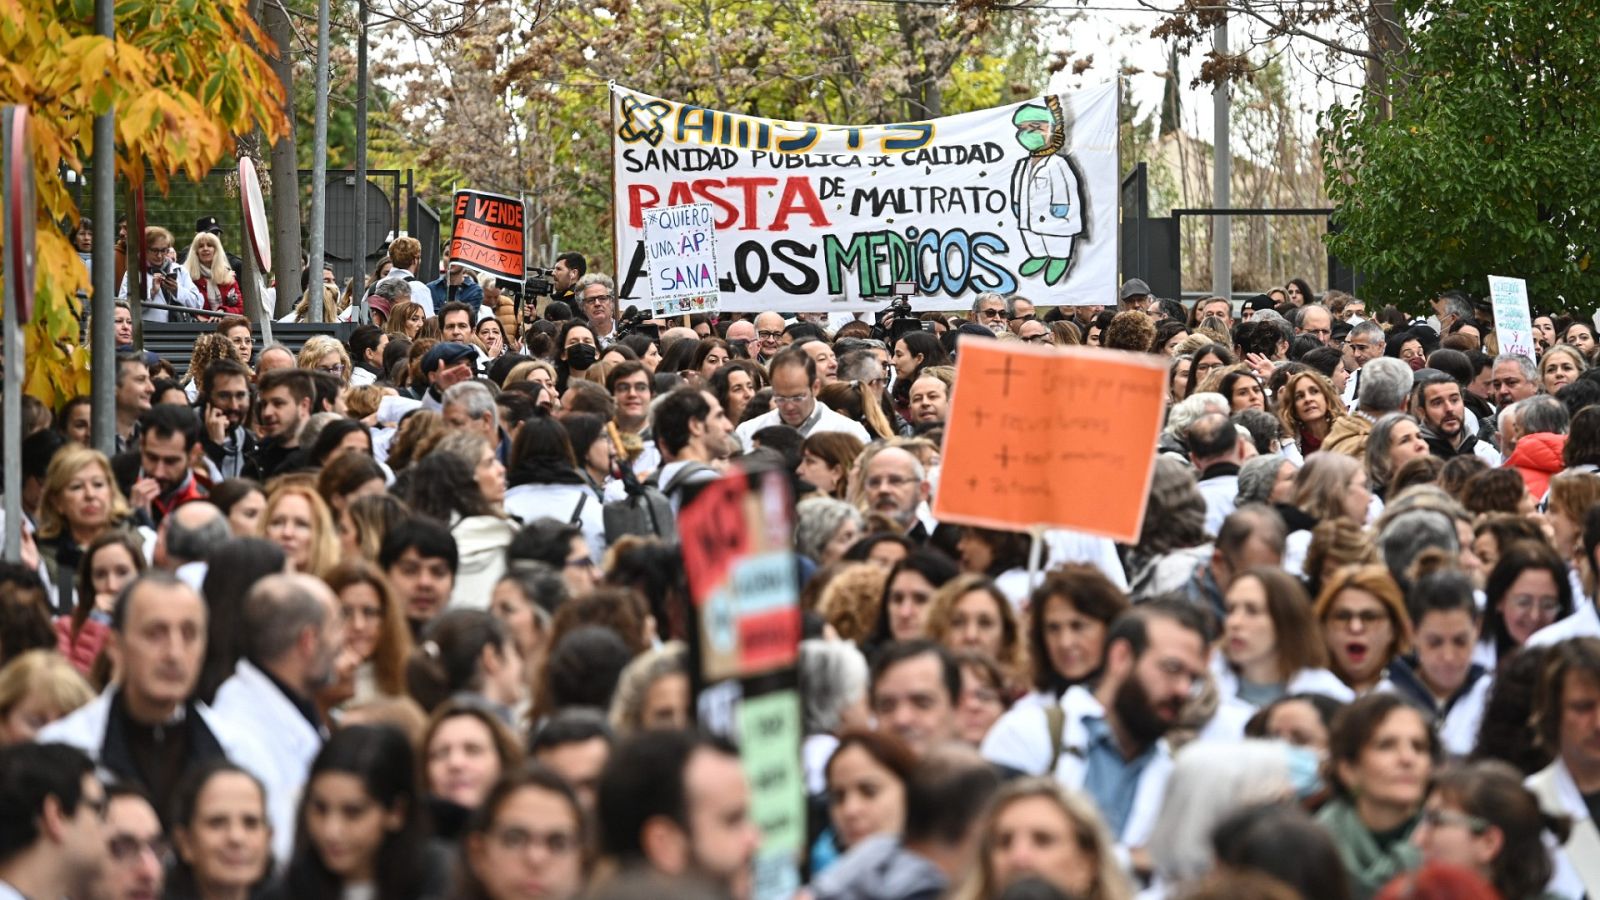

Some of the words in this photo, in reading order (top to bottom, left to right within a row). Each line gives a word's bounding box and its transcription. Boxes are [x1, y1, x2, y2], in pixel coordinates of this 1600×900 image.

[623, 147, 738, 173] SANIDAD
[750, 149, 862, 169] PUBLICA
[901, 142, 1005, 166] CALIDAD
[820, 176, 847, 200] DE
[850, 186, 1007, 217] MALTRATO
[474, 198, 523, 228] VENDE
[458, 221, 518, 246] ATENCION
[650, 240, 676, 259] UNA
[681, 232, 705, 254] AP
[453, 241, 521, 268] PRIMARIA
[719, 239, 820, 295] OS
[660, 263, 713, 290] SANA
